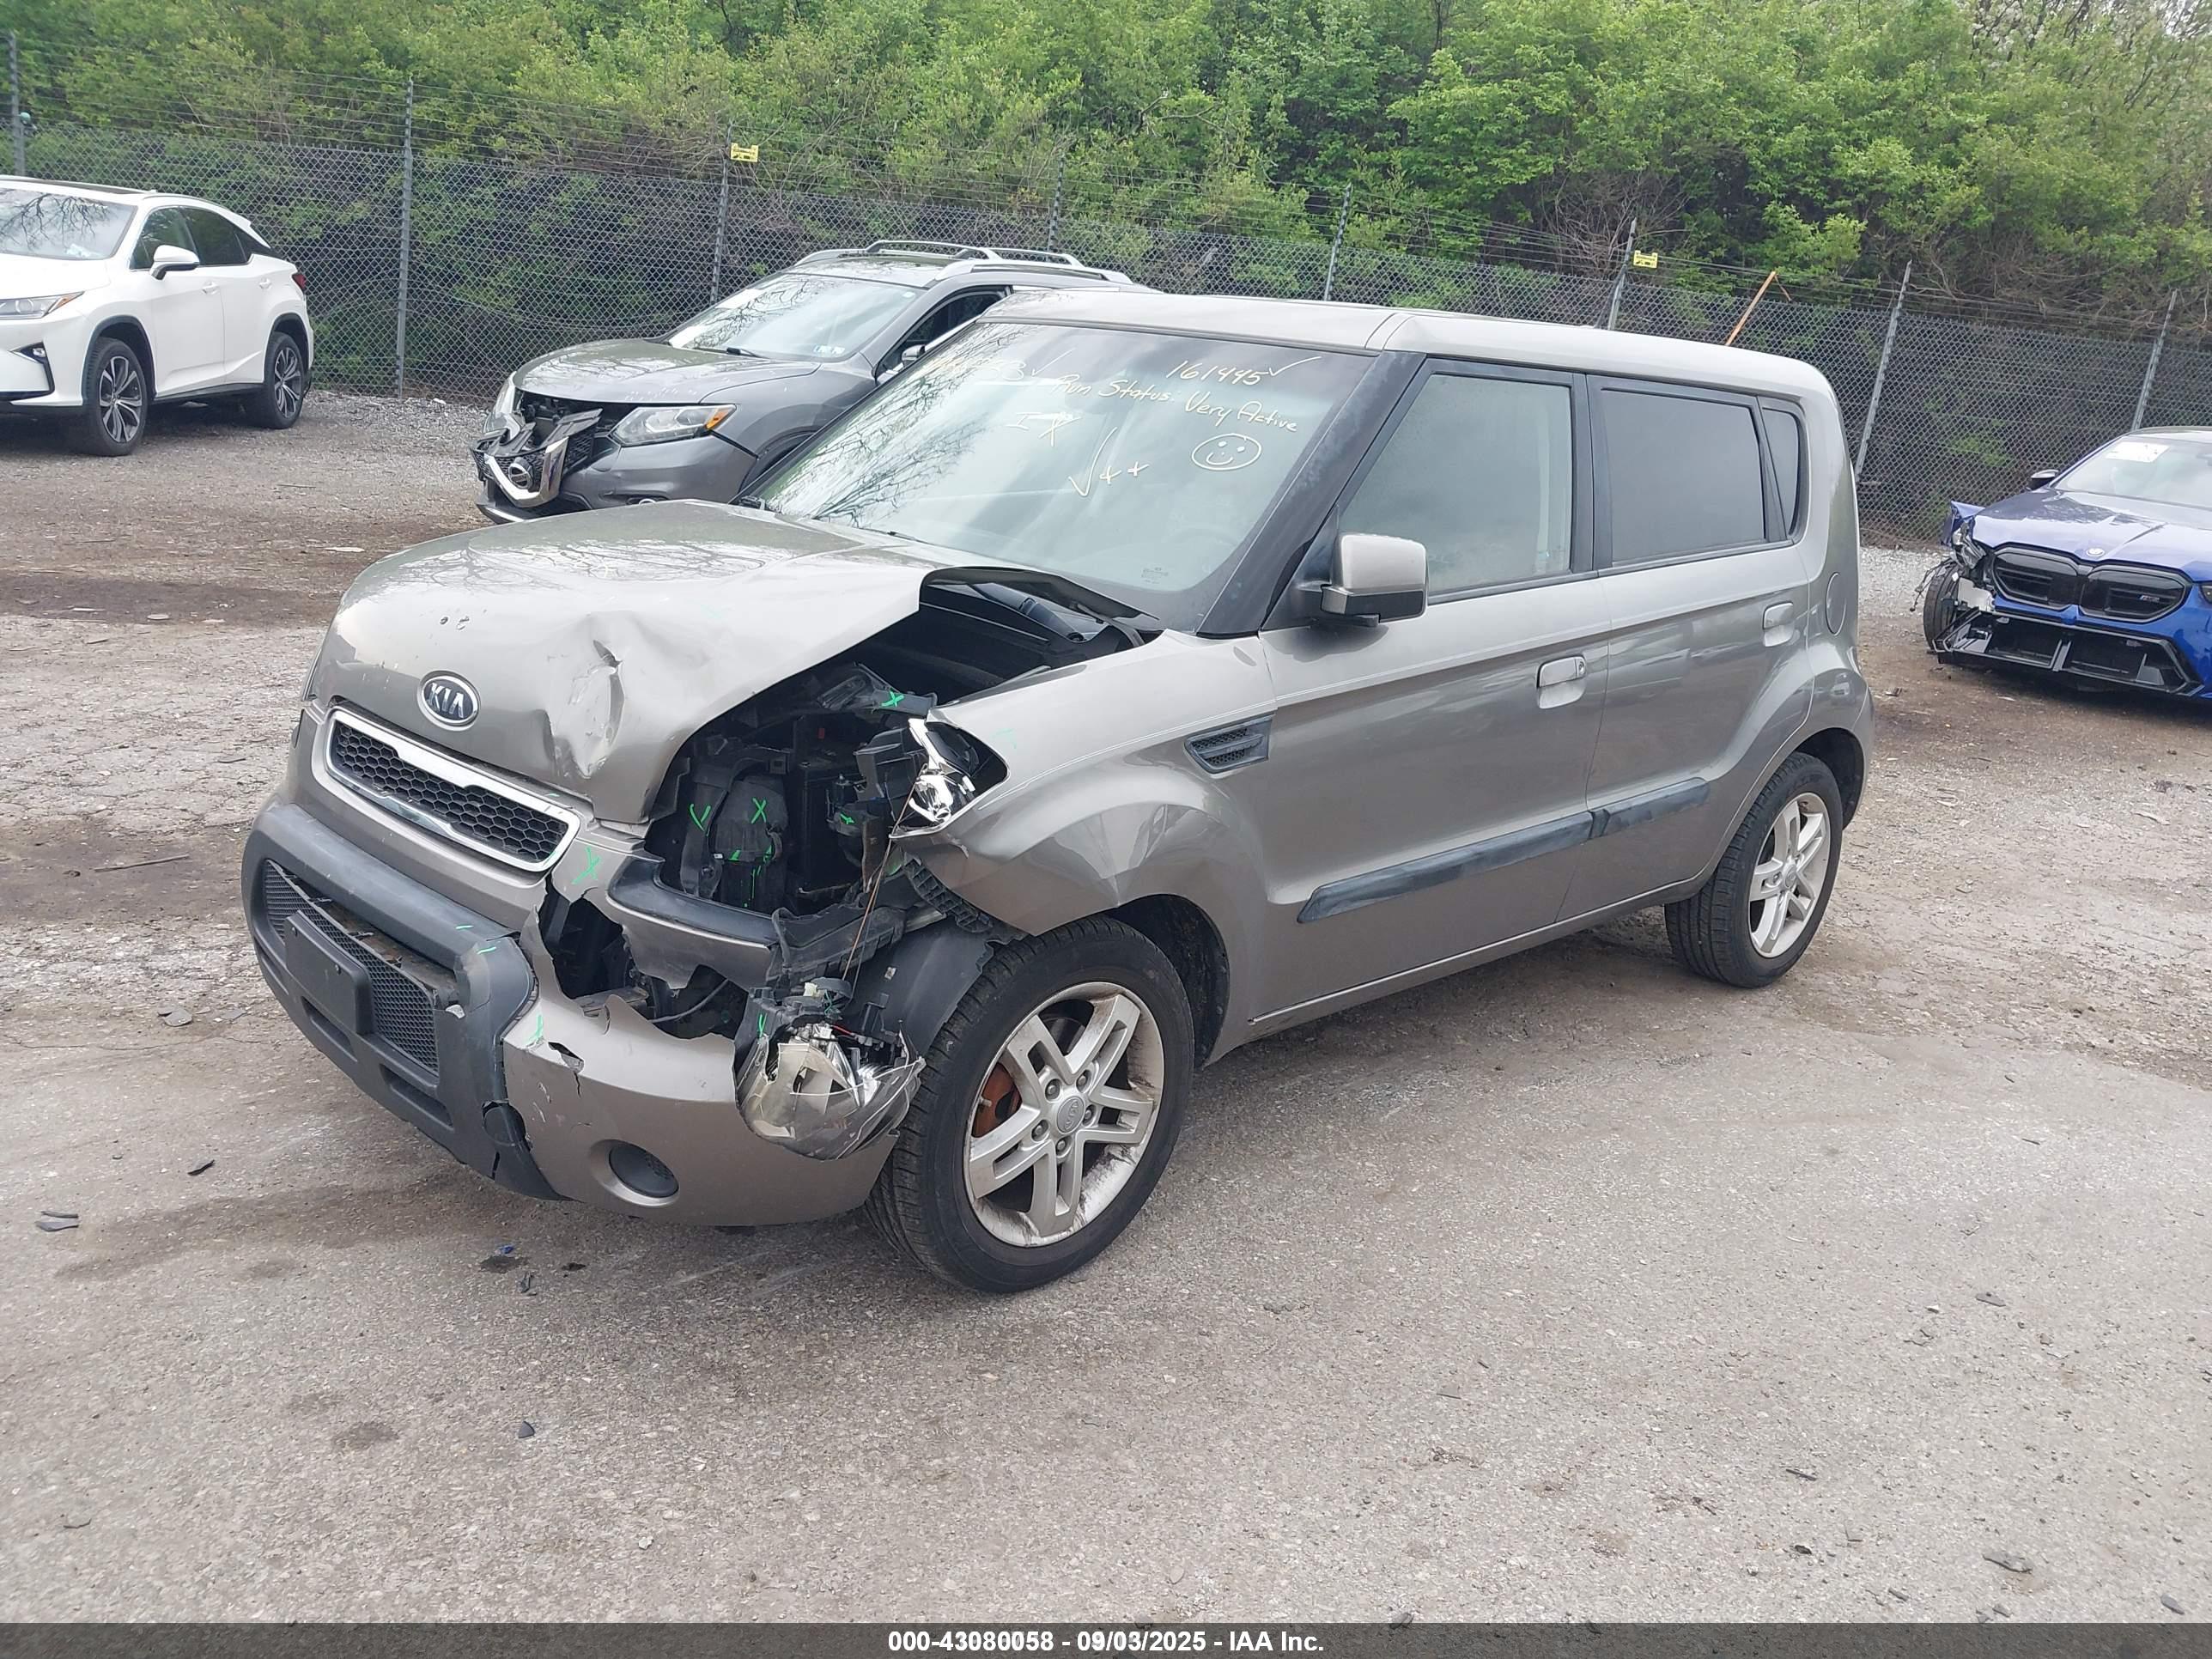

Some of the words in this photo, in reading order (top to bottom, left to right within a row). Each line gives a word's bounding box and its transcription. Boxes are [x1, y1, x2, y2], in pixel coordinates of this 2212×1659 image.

[1165, 360, 1268, 386] 161445
[1051, 374, 1093, 396] Run
[1184, 391, 1233, 427] Very
[1237, 400, 1298, 432] Active
[425, 682, 465, 719] KIA
